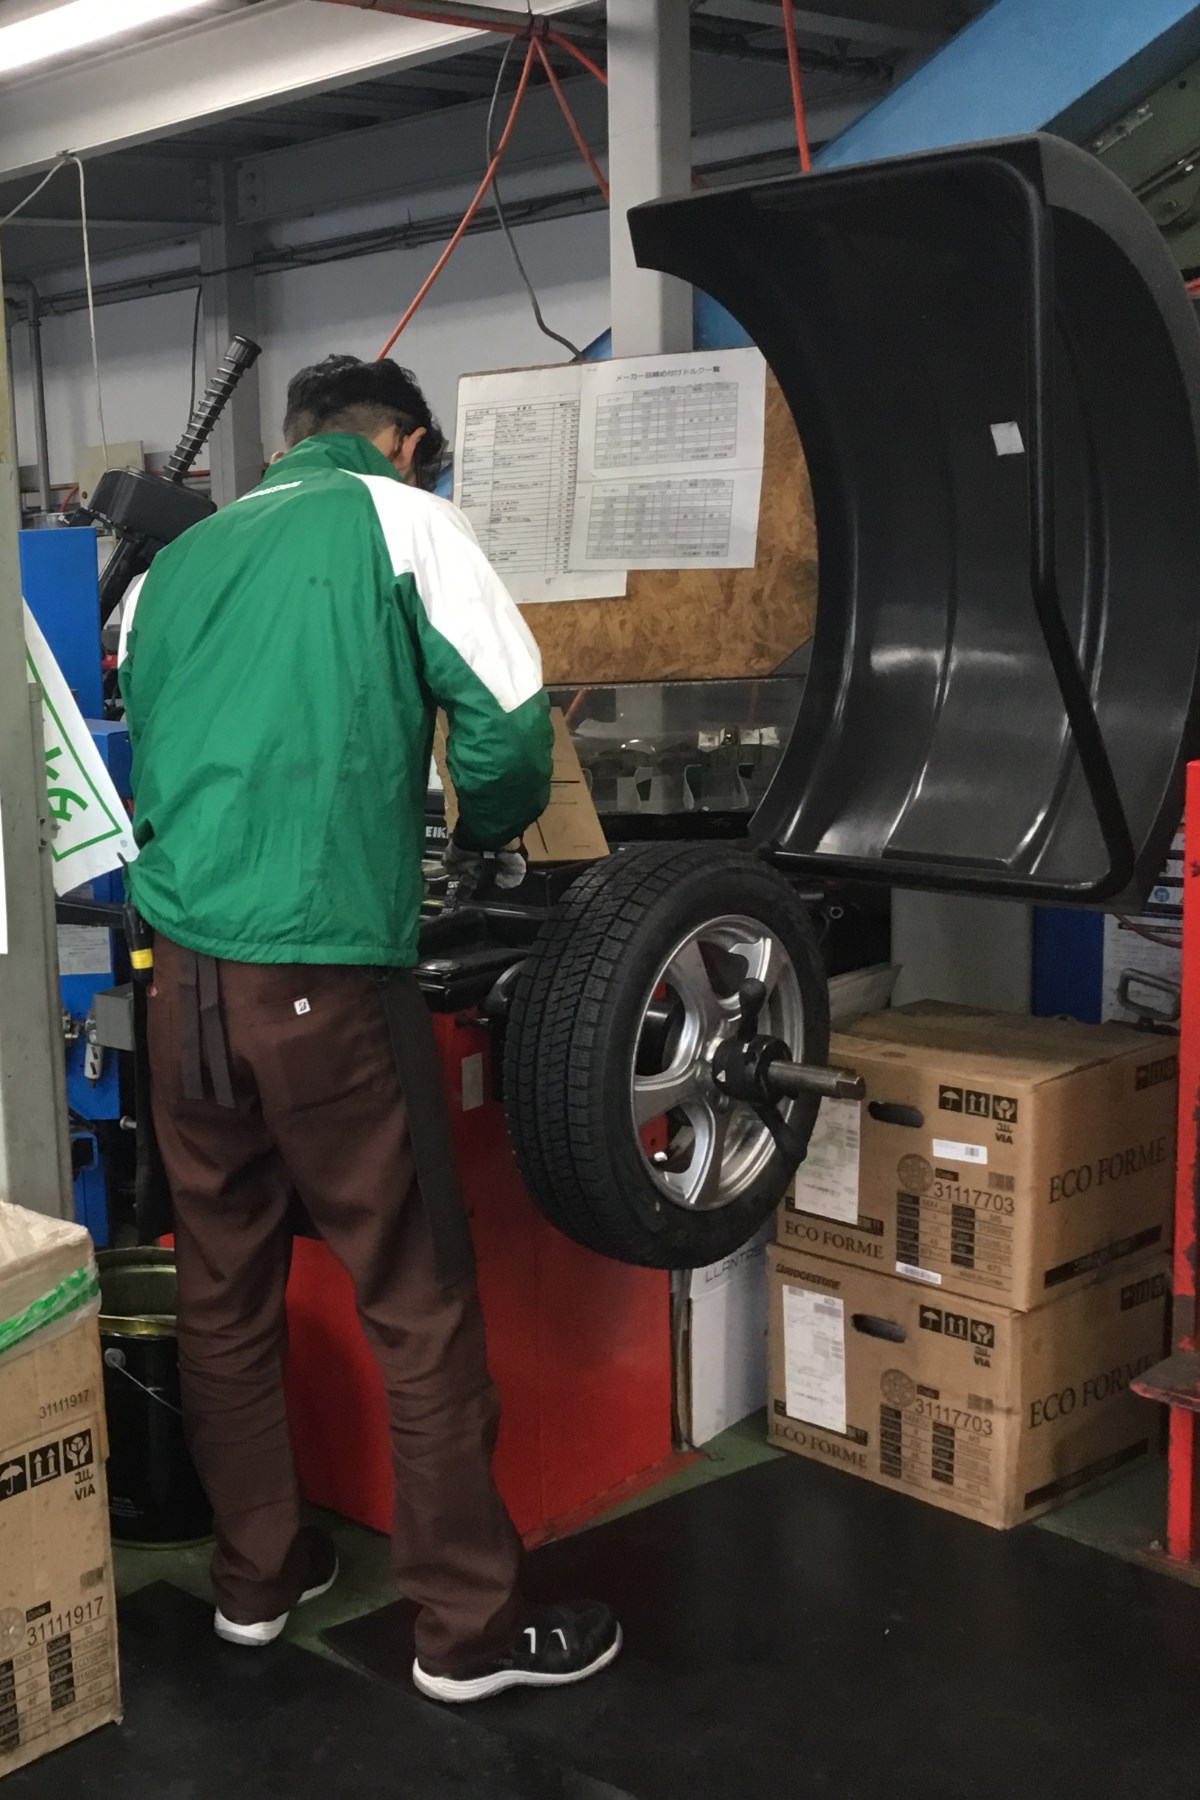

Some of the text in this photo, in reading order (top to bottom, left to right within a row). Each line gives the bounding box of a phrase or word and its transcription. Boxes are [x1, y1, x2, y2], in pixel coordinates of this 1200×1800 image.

[425, 825, 449, 839] EIK
[995, 1132, 1014, 1145] VIA
[1048, 1136, 1167, 1205] ECO FORME
[934, 1181, 1015, 1214] 31117703
[785, 1220, 884, 1260] ECO FORME
[38, 1389, 90, 1420] 31111917
[915, 1397, 993, 1436] 31117703
[1028, 1387, 1076, 1430] ECO
[775, 1423, 868, 1469] ECO FORME
[74, 1484, 96, 1501] VIA
[26, 1595, 105, 1647] 31111917
